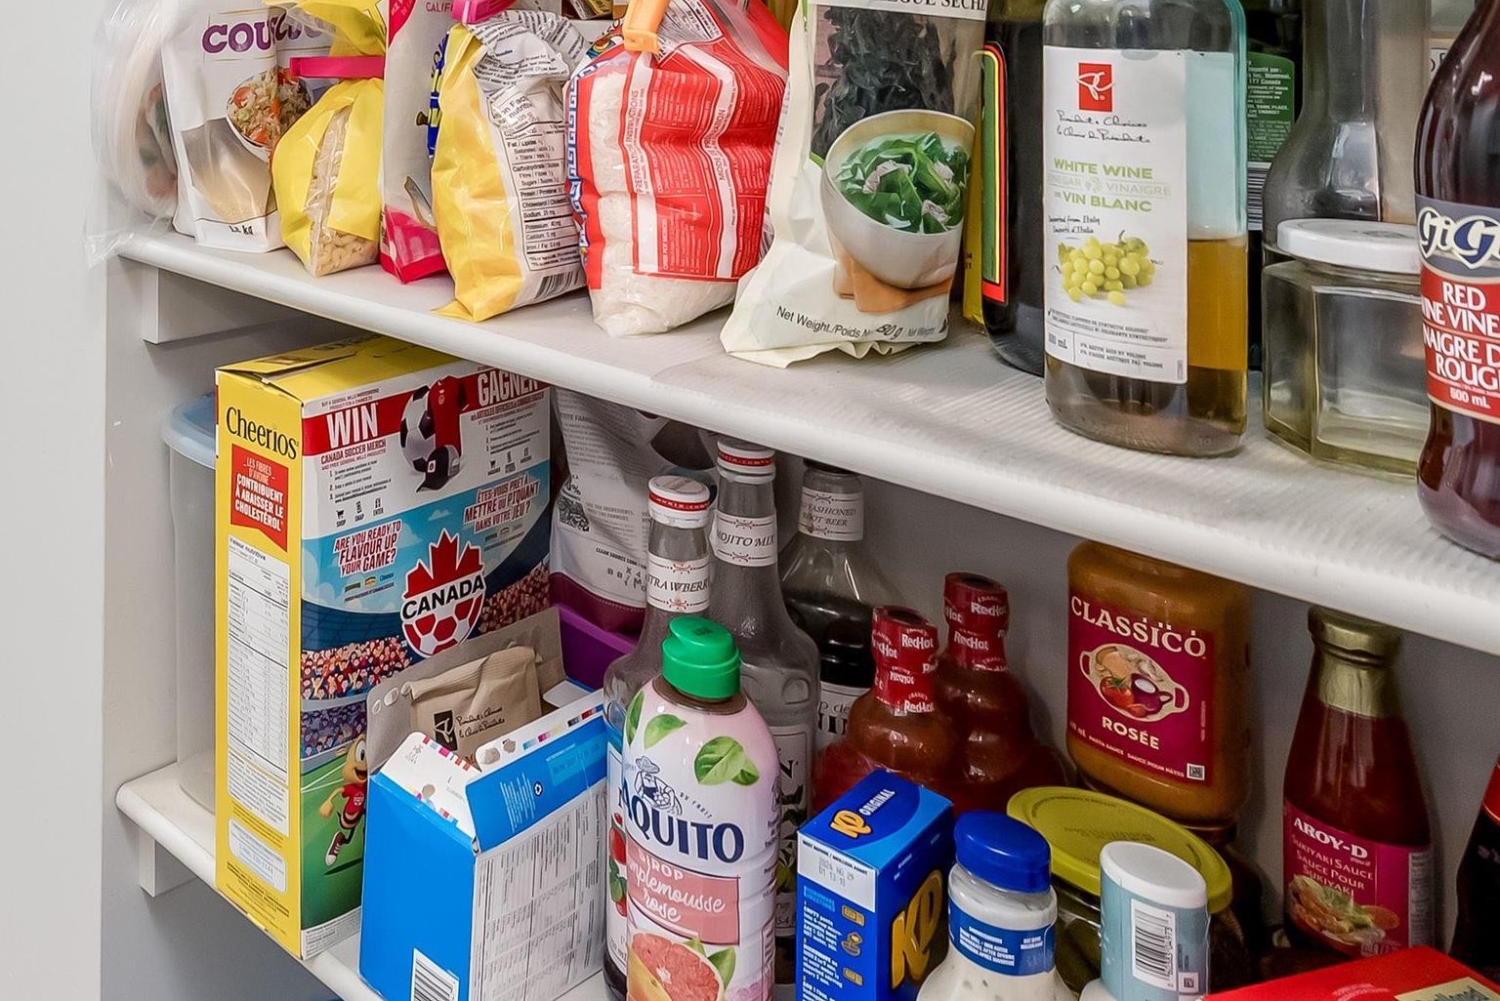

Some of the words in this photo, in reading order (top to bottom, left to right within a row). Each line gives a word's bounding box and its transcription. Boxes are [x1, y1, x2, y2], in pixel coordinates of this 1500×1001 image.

[627, 90, 640, 144] INSTRUCTIONS
[1054, 158, 1098, 175] WHITE
[1102, 164, 1153, 180] WINE
[1063, 191, 1086, 206] VIN
[1091, 196, 1152, 213] BLANC
[1106, 182, 1172, 197] VINAIGRE
[1083, 215, 1101, 226] Italy
[1421, 296, 1446, 326] INE
[1442, 281, 1486, 312] RED
[776, 306, 795, 322] Net
[1472, 394, 1491, 409] mL
[226, 406, 297, 460] Cheerios
[326, 402, 378, 449] WIN
[247, 456, 256, 469] LES
[256, 459, 272, 475] FIBRES
[321, 448, 344, 465] CANADA
[344, 444, 366, 459] SOCCER
[366, 438, 387, 454] MERCH
[235, 483, 241, 498] À
[241, 488, 274, 514] ABAISSER
[275, 504, 284, 519] LE
[236, 473, 284, 503] CONTRIBUENT
[465, 499, 498, 522] METTRE
[508, 482, 540, 506] PIQUANT
[336, 519, 347, 528] SHOP
[355, 513, 365, 522] SNAP
[373, 507, 384, 517] ENTER
[475, 517, 492, 533] DANS
[493, 510, 511, 526] VOTRE
[511, 503, 525, 521] JEU
[825, 517, 848, 527] BEER
[335, 536, 350, 552] ARE
[351, 532, 366, 546] YOU
[367, 525, 391, 541] READY
[392, 520, 402, 532] TO
[340, 538, 383, 565] FLAVOUR
[384, 533, 398, 550] UP
[342, 559, 361, 576] YOUR
[362, 548, 397, 572] GAME?
[402, 574, 485, 621] CANADA
[649, 573, 709, 593] TRAWBERR
[953, 631, 990, 650] RedHot
[1070, 595, 1206, 657] CLASSICO
[902, 633, 934, 650] RedHot
[904, 699, 935, 714] RedHot
[1102, 715, 1160, 750] ROSÉE
[1106, 743, 1124, 756] SAUCE
[1127, 752, 1147, 765] SAUCE
[1147, 759, 1165, 771] POUR
[692, 801, 713, 820] FRUIT
[859, 788, 896, 817] ORIGINAL
[830, 809, 872, 839] KD
[1294, 817, 1369, 860] AROY-D
[638, 849, 683, 881] SIROP
[1292, 834, 1333, 866] SUKIYAKI
[1335, 858, 1374, 880] SAUCE
[1296, 849, 1329, 876] SAUCE
[1331, 869, 1365, 890] POUR
[1302, 864, 1355, 896] SUKIYAKI
[642, 889, 682, 924] rose
[891, 869, 944, 990] KD
